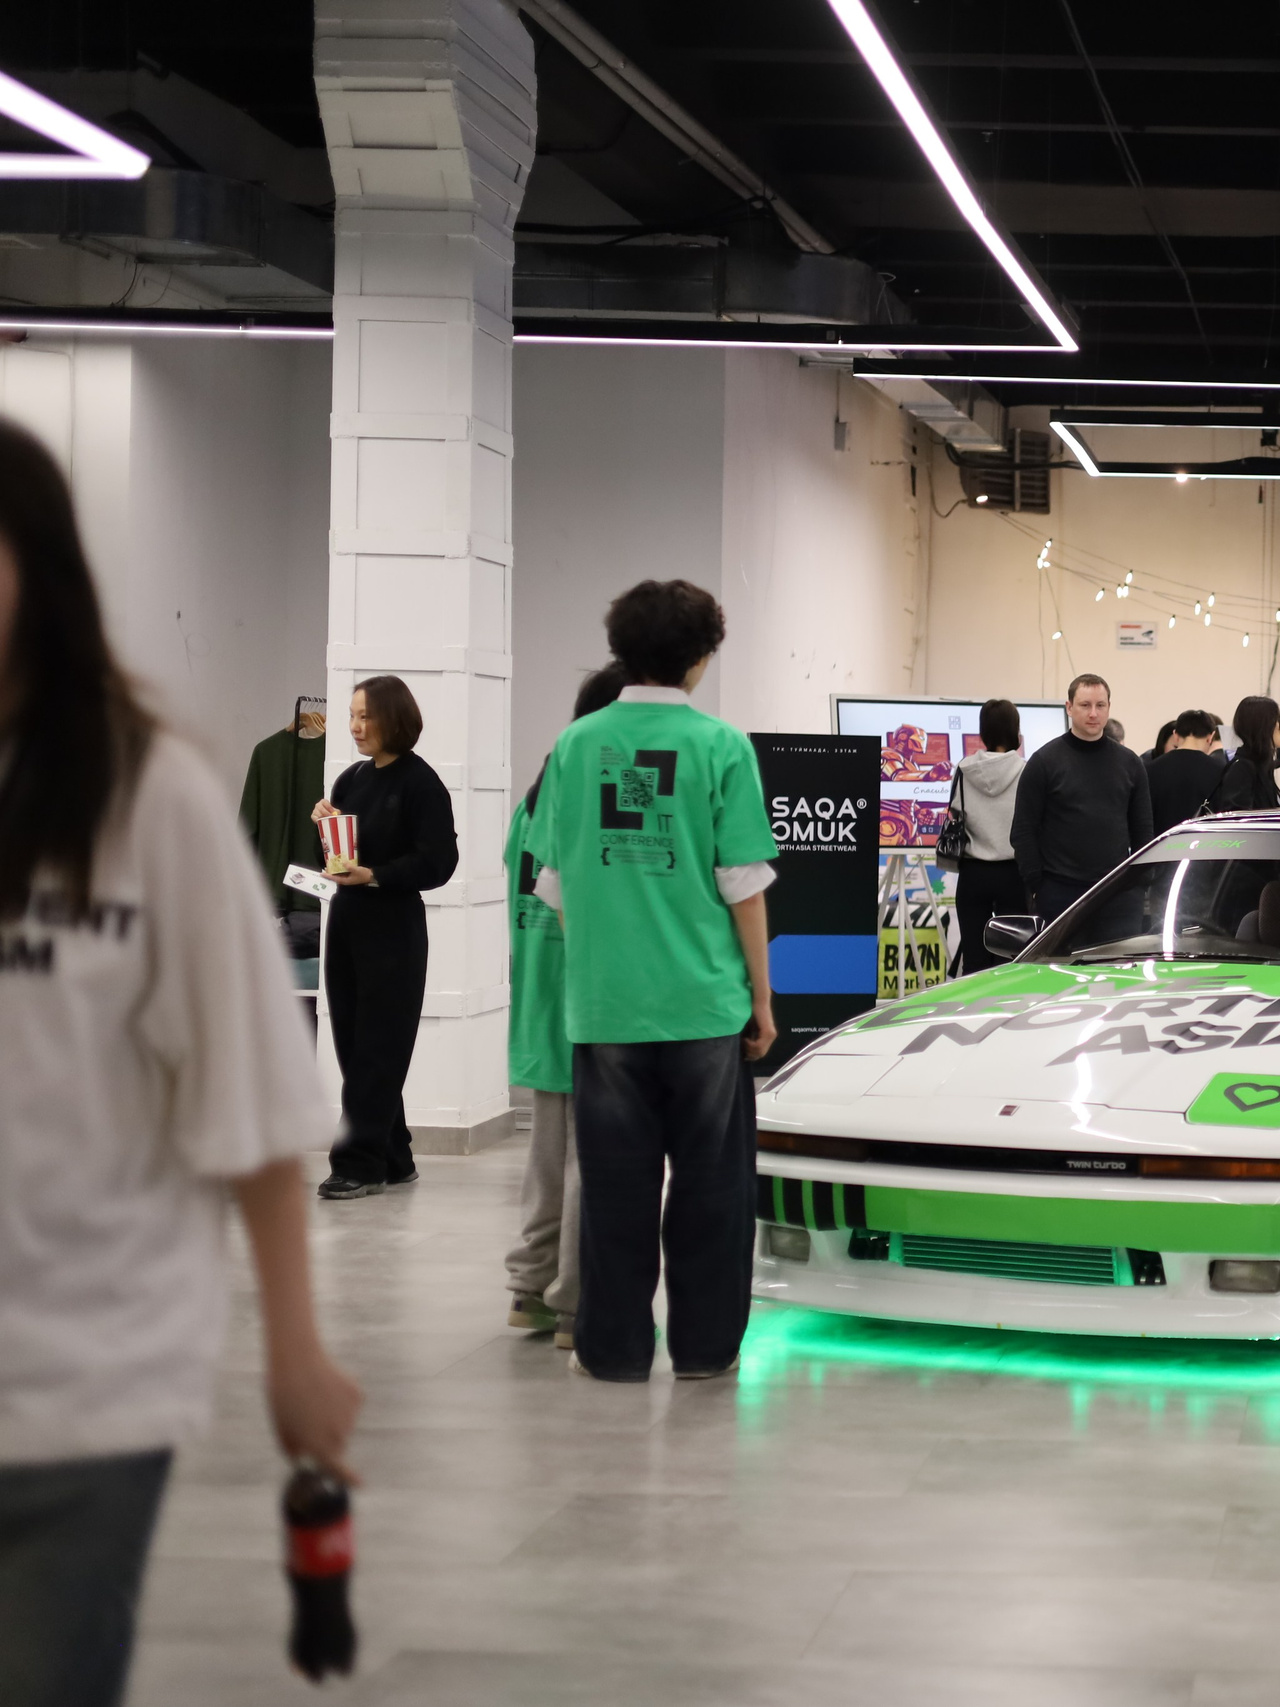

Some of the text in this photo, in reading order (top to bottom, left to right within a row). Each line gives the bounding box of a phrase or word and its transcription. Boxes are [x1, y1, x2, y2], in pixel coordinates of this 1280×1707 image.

[913, 786, 949, 794] Спасибо
[657, 813, 674, 833] IT
[600, 834, 675, 849] CONFERENCE
[775, 844, 857, 852] ORTH ASIA STREETWEAR
[1066, 1160, 1092, 1169] TWIN
